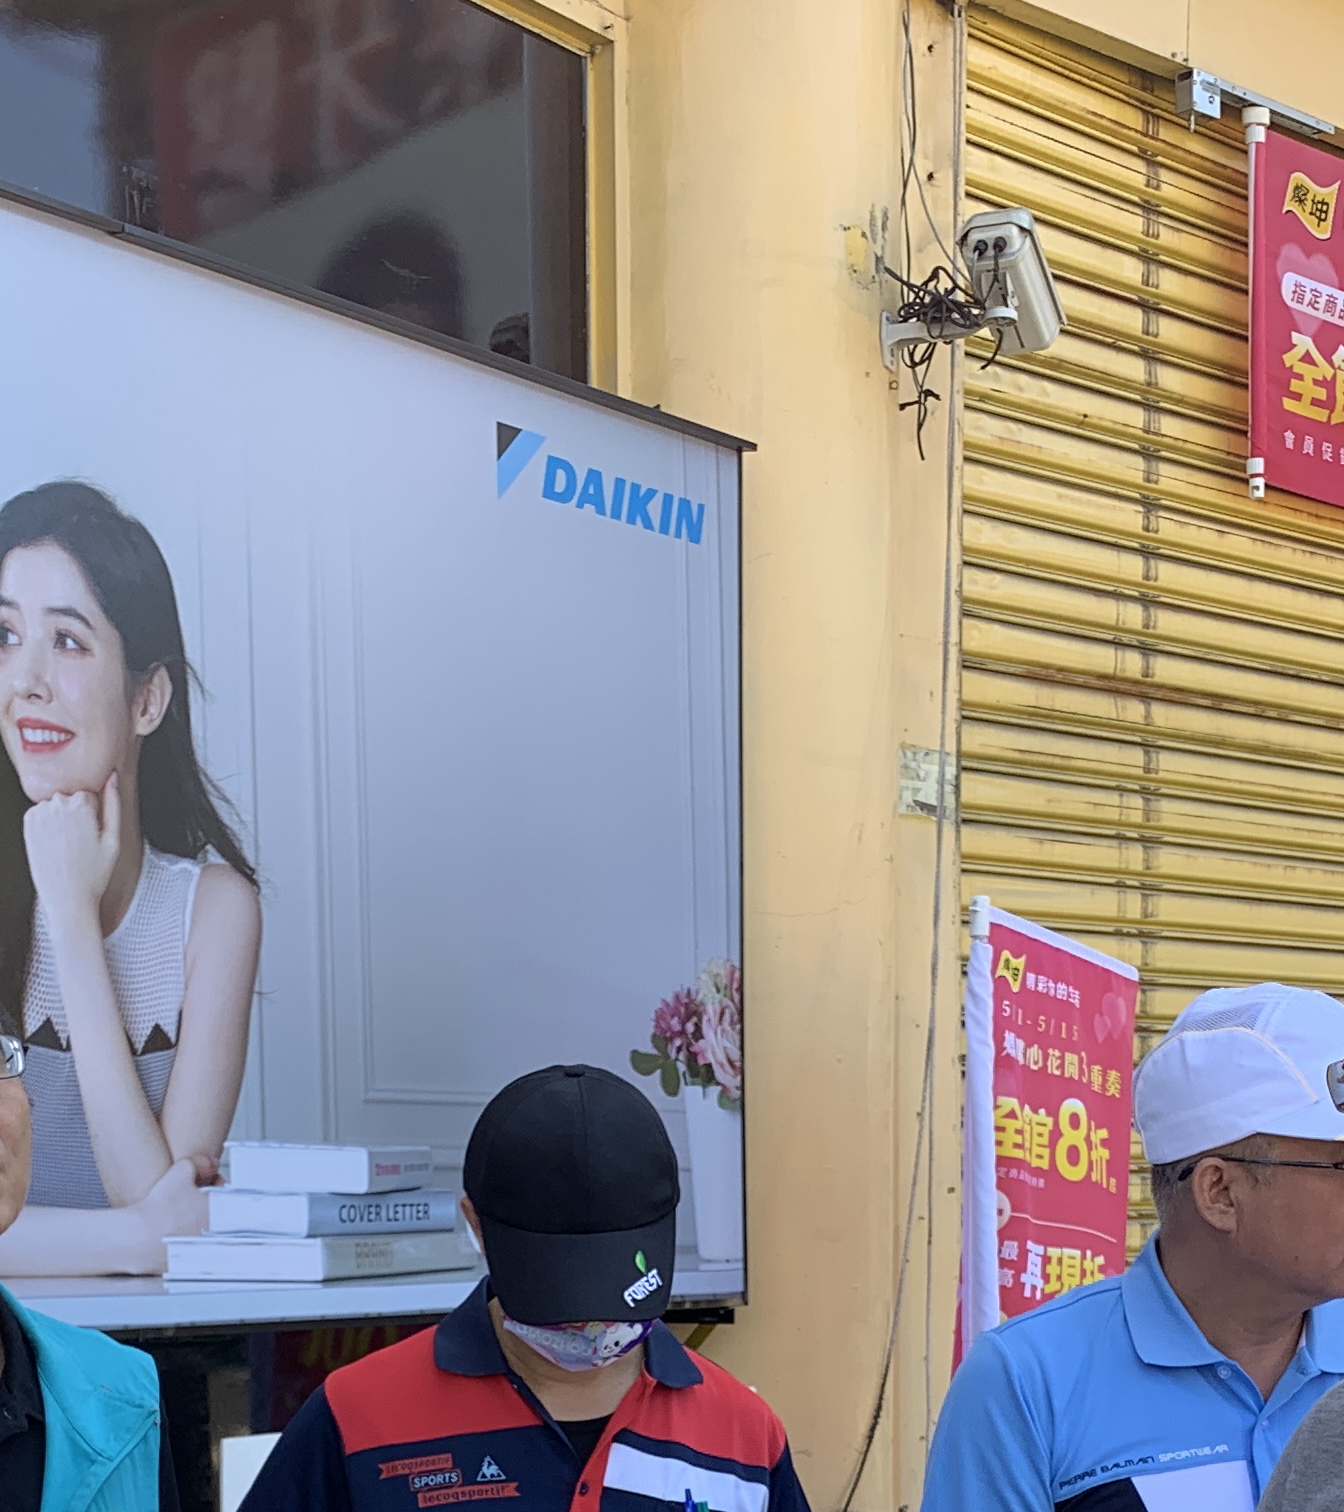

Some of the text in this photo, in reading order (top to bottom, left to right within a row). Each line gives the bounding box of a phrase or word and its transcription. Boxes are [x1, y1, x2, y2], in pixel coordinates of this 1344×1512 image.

[1291, 182, 1330, 228] 燦坤
[540, 454, 705, 546] DAIKIN
[339, 1202, 431, 1224] COVER LETTER
[623, 1267, 663, 1308] FOREST
[413, 1472, 458, 1488] SPORTS
[1059, 1444, 1229, 1490] PIERRE BALMAIN SPORTWEAR
